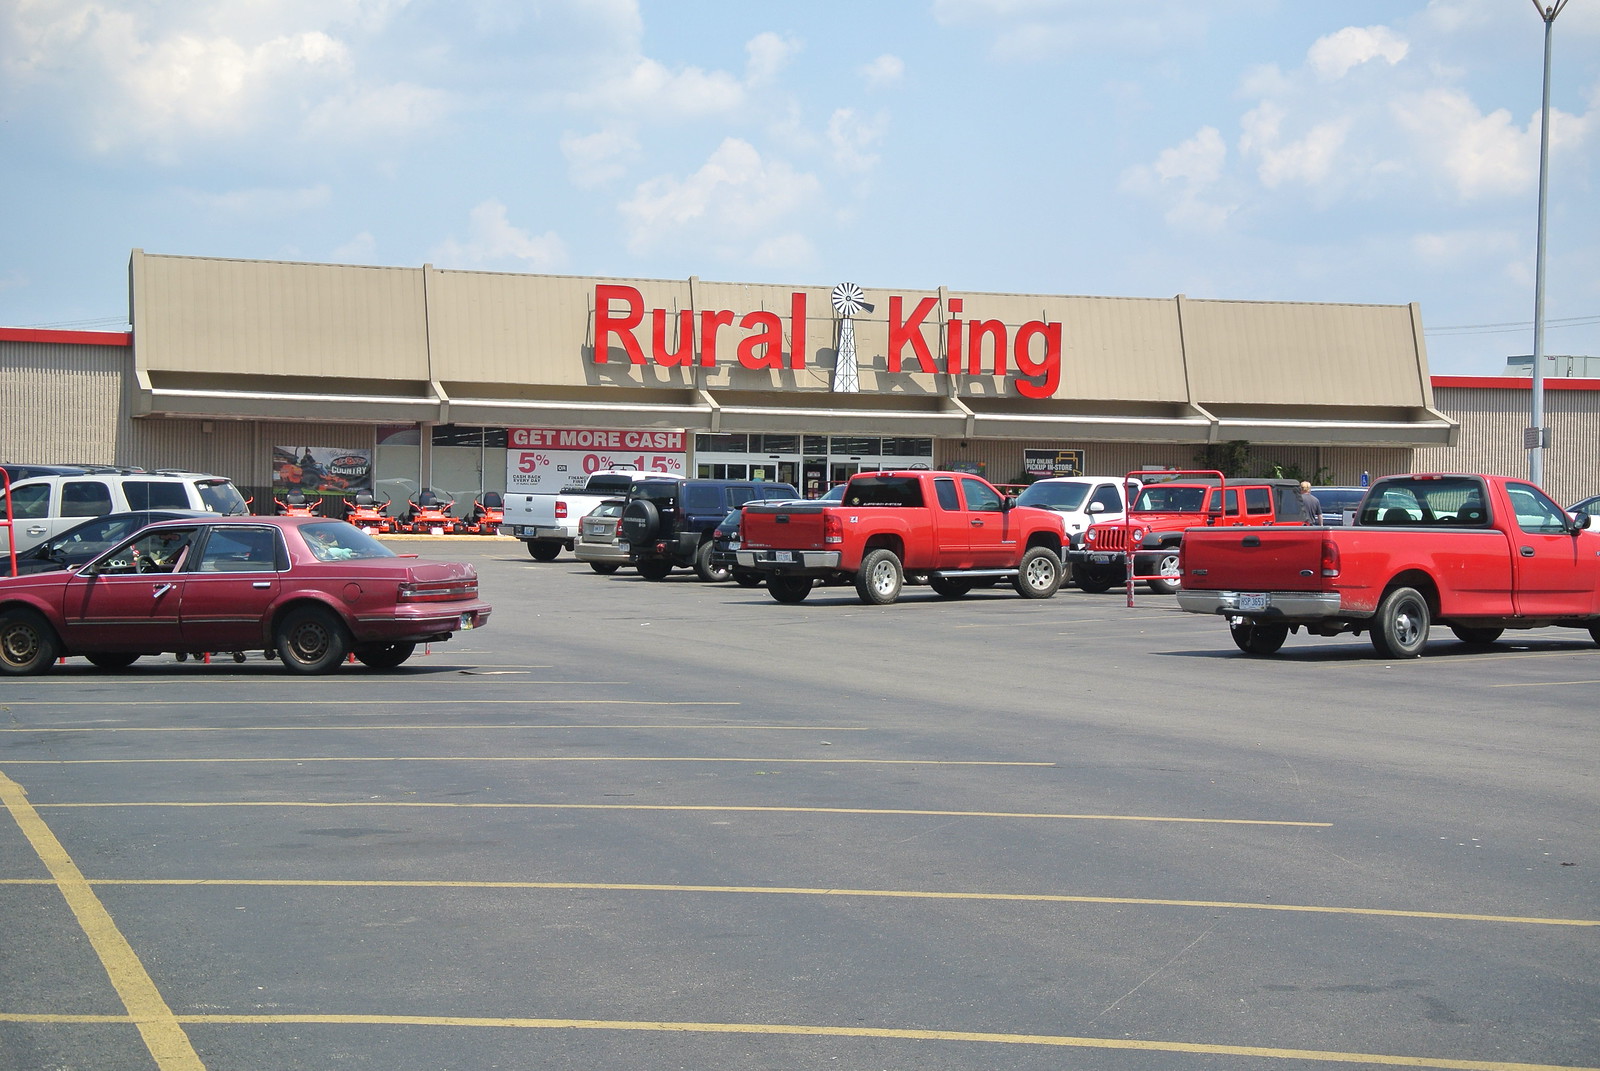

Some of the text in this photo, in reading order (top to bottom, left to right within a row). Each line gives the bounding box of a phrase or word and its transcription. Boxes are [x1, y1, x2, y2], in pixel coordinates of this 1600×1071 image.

[594, 284, 1062, 399] Rural King
[513, 430, 682, 448] GET MORE CASH
[331, 466, 367, 475] COUNTRY
[518, 452, 550, 473] 5%
[634, 456, 680, 473] 15%
